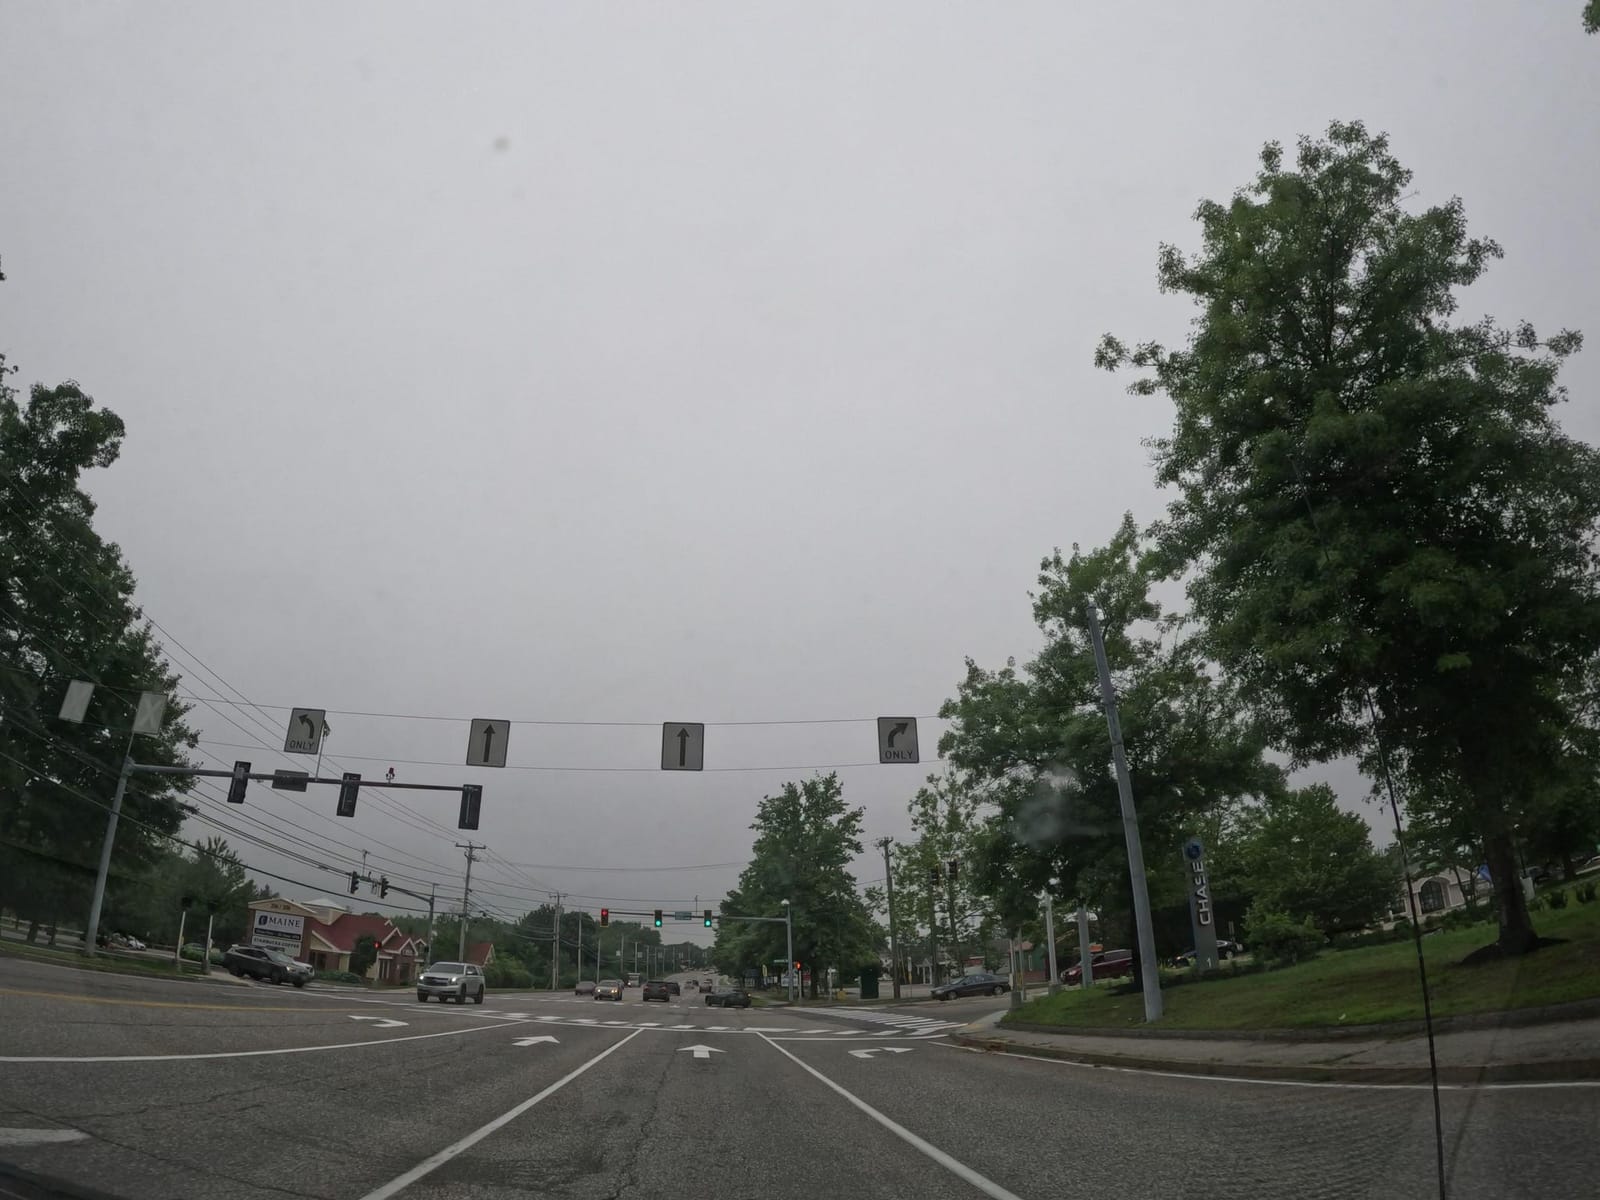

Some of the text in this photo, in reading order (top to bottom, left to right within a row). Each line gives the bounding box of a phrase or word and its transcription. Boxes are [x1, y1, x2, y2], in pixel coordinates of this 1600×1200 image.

[289, 740, 315, 750] ONLY
[885, 750, 913, 760] ONLY
[1192, 861, 1211, 925] CHASE
[269, 917, 301, 928] MAINE
